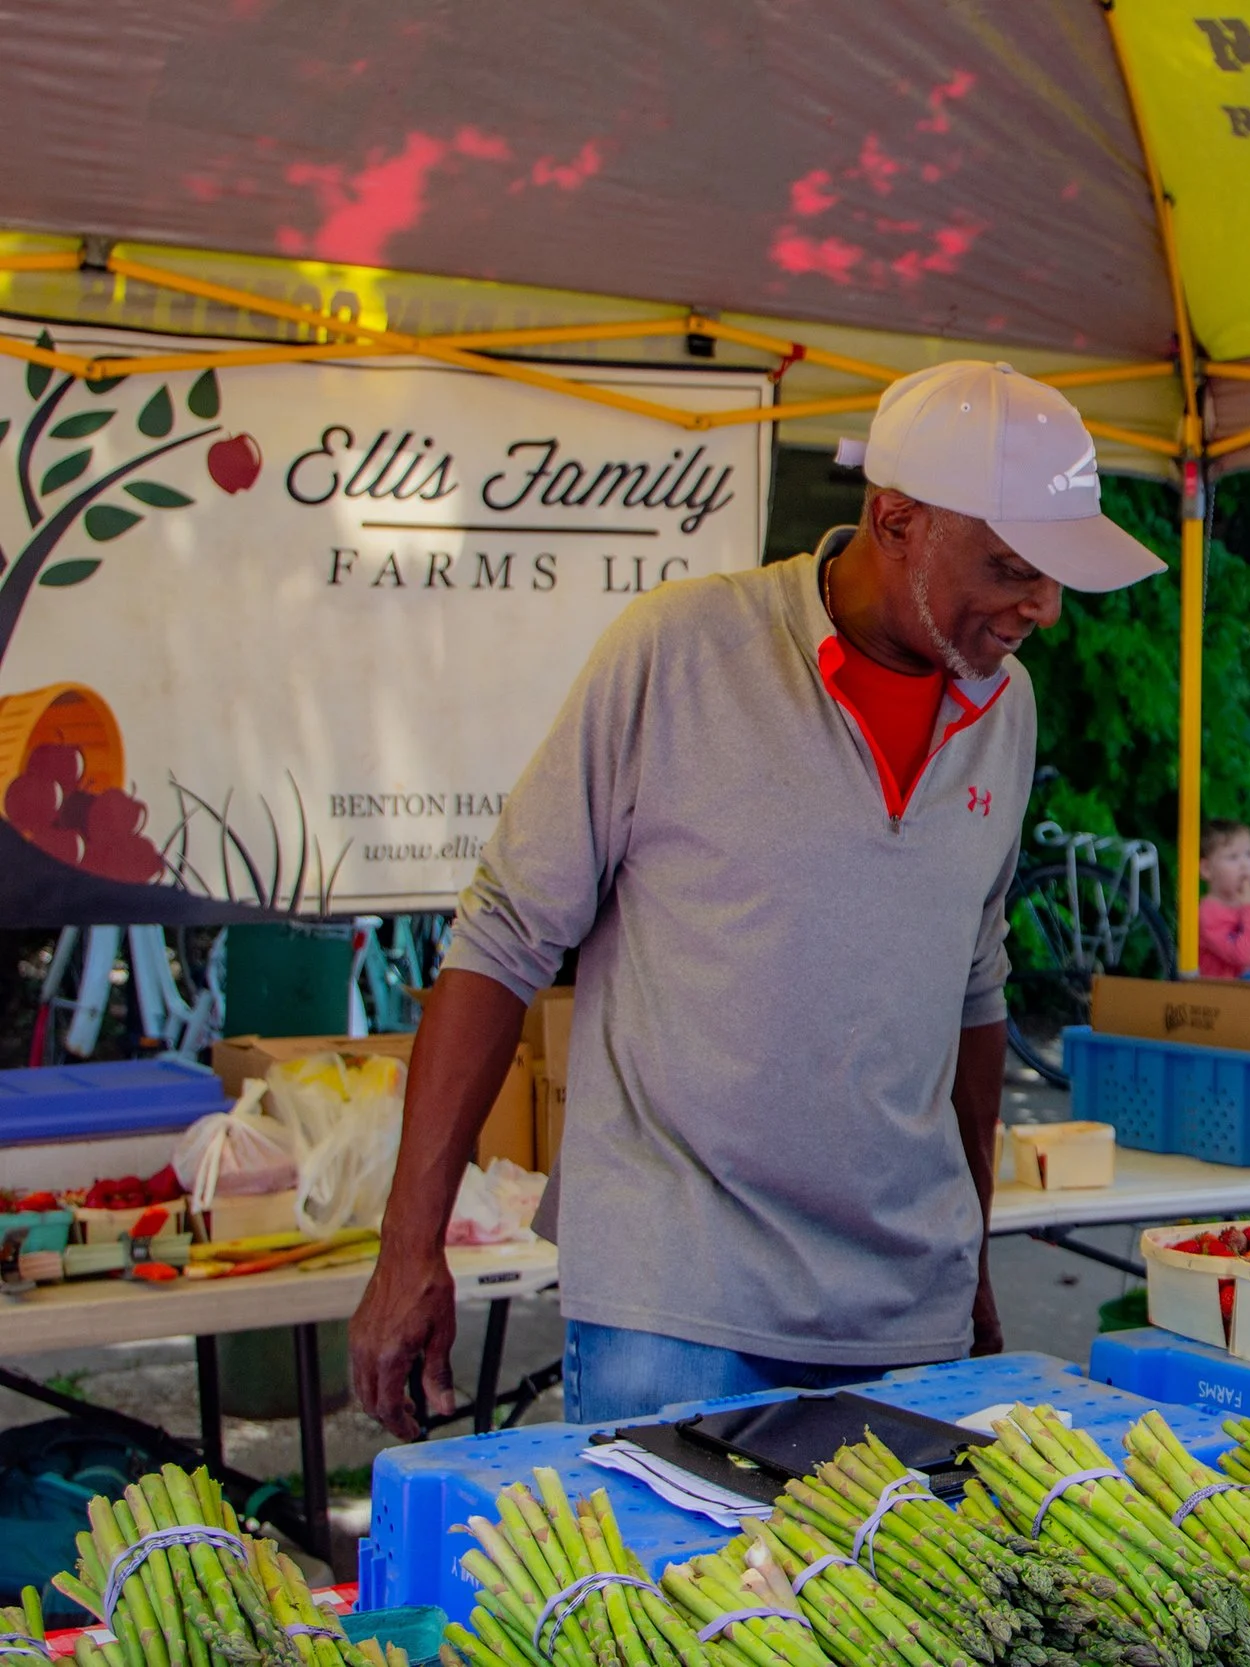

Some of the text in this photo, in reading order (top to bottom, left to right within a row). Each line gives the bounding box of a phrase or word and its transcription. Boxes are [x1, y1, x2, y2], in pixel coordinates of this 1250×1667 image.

[286, 424, 735, 535] Ellis Family
[327, 548, 560, 592] FARMS
[330, 793, 447, 818] BENTON
[1197, 1380, 1243, 1409] FARMS
